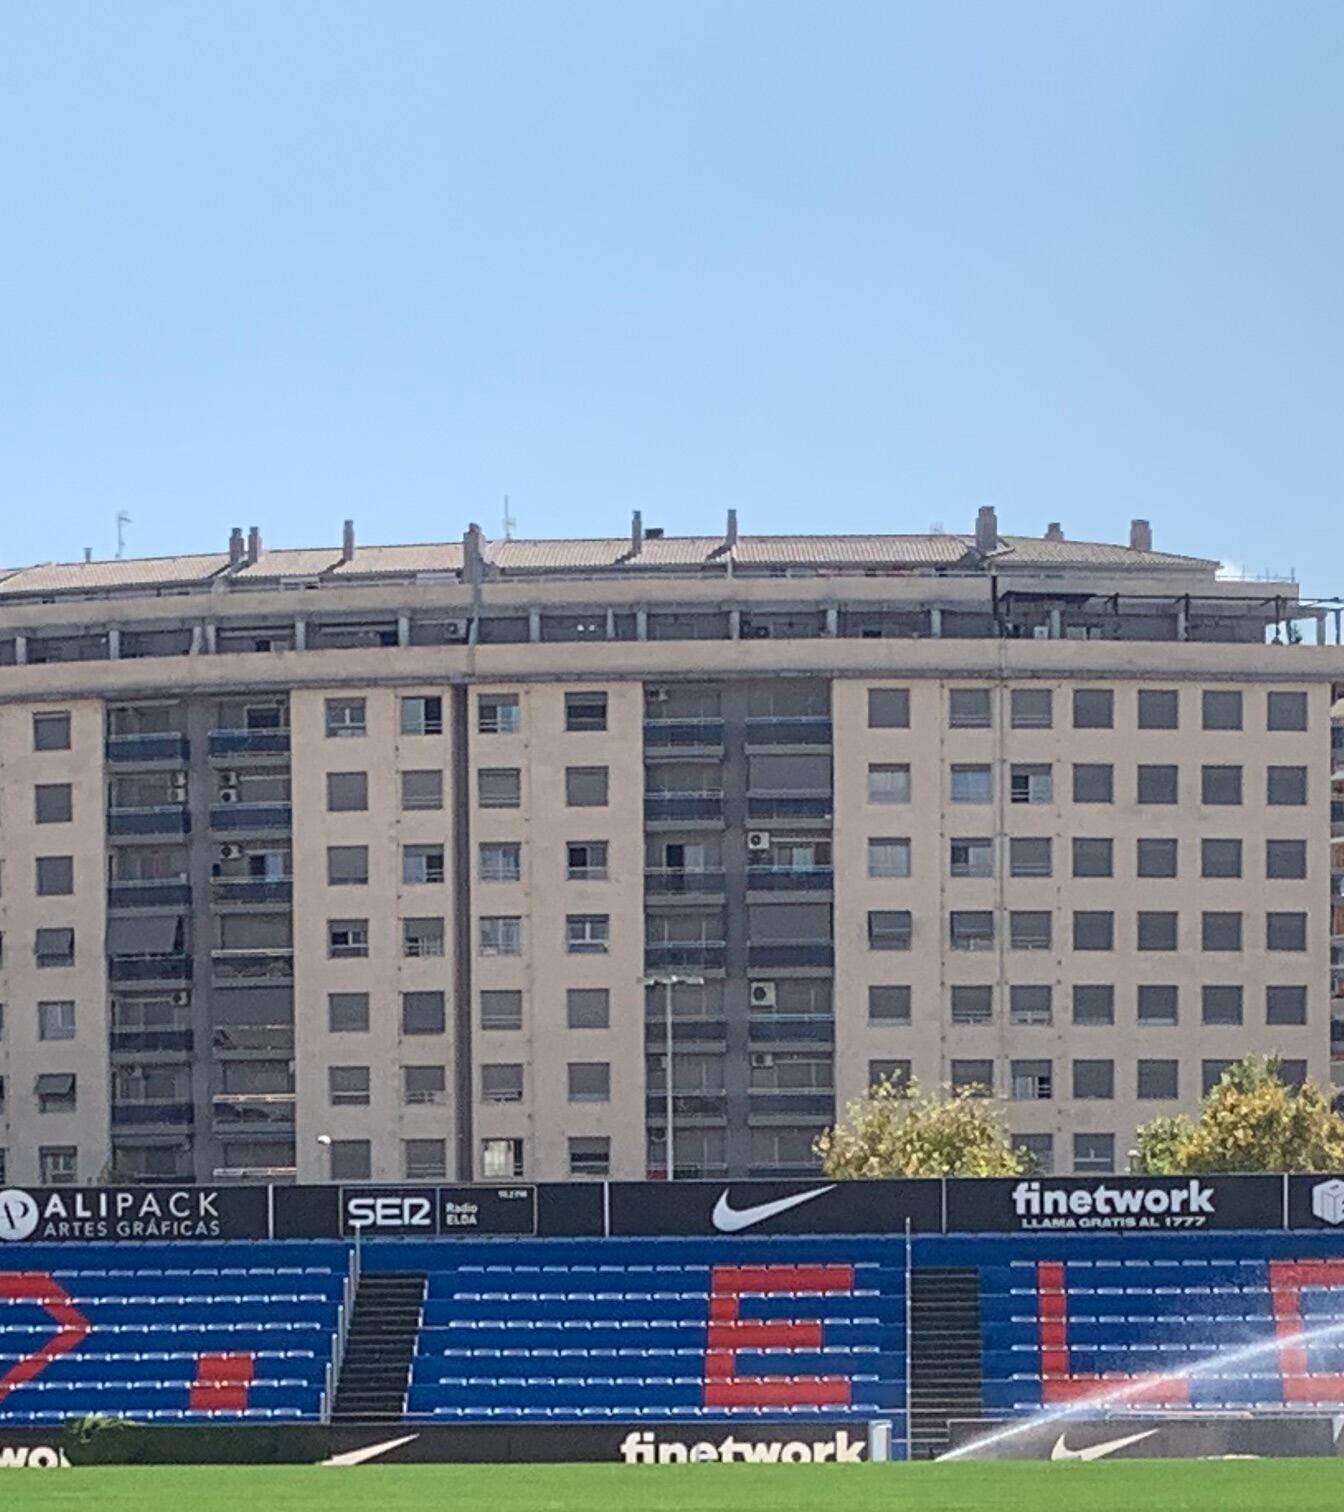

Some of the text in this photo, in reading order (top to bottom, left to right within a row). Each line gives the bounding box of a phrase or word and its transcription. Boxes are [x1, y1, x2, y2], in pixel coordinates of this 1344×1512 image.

[44, 1192, 219, 1218] ALIPACK
[1012, 1180, 1215, 1215] finetwork
[348, 1198, 432, 1226] SER
[1022, 1216, 1206, 1229] LLAMA GRATIS AL 1777
[44, 1217, 220, 1237] ARTES GRÁFICAS
[620, 1431, 866, 1463] finetwork
